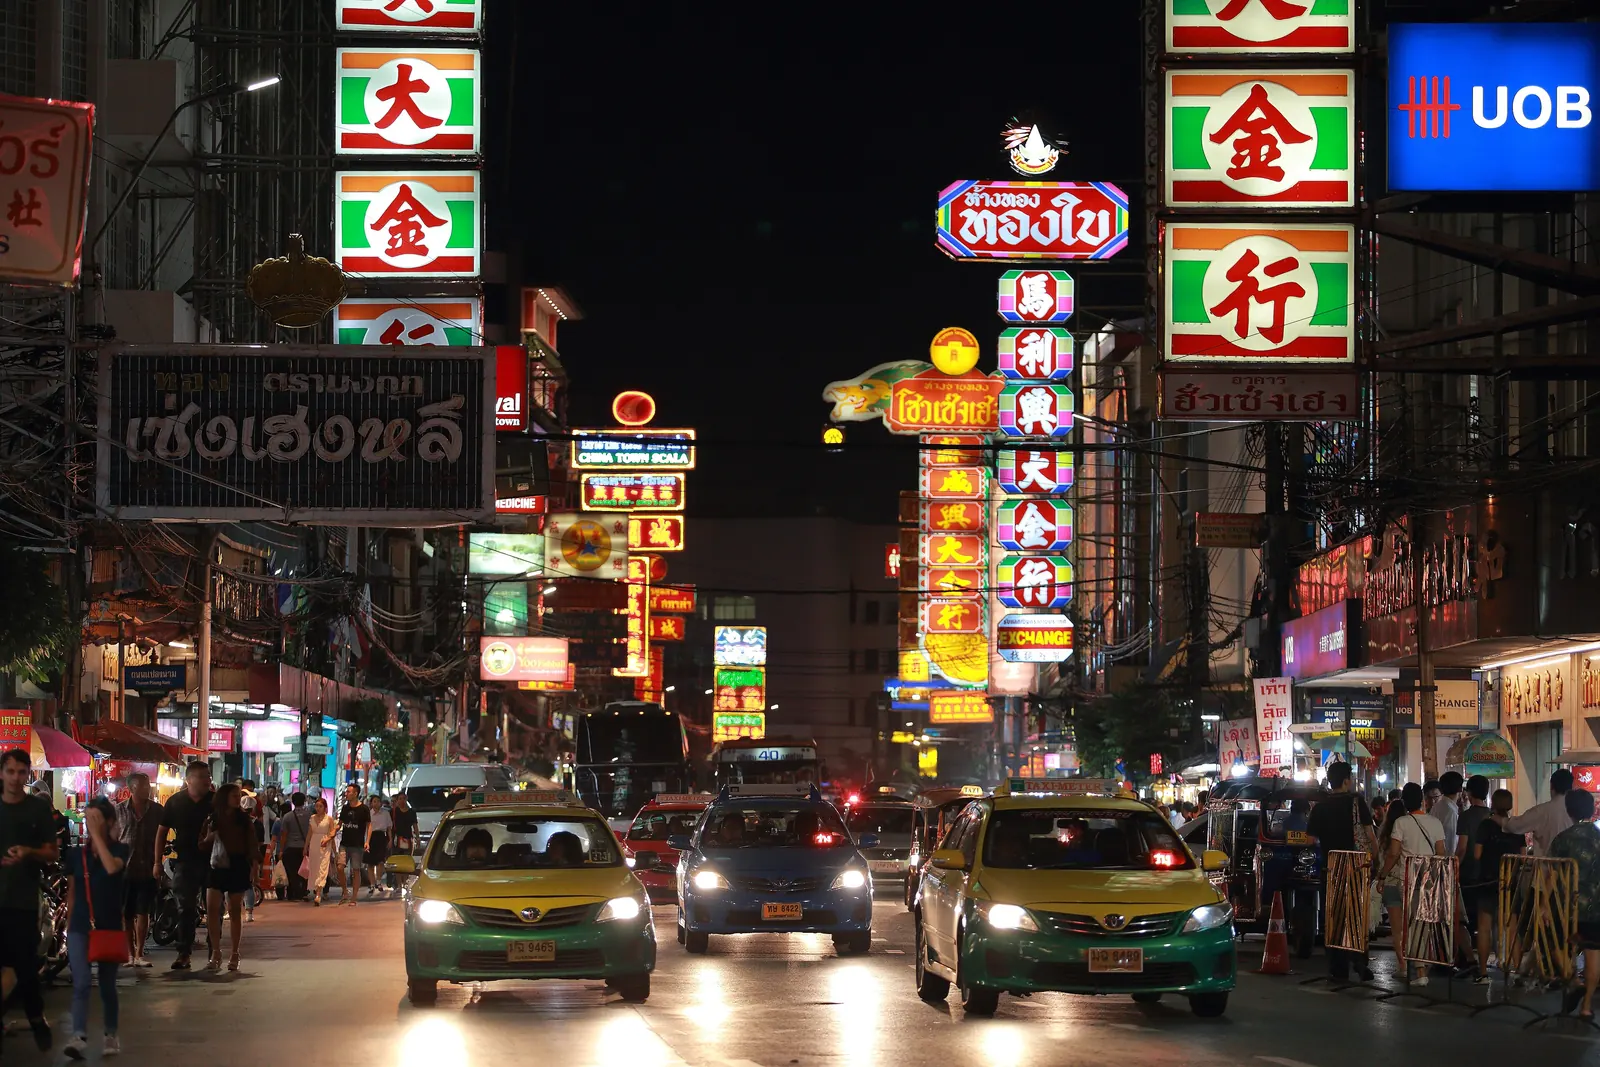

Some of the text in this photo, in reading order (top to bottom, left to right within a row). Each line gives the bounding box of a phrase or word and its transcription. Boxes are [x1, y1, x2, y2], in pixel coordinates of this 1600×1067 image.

[1471, 86, 1592, 129] UOB
[965, 187, 1040, 208] ห้างทอง
[959, 191, 1110, 246] ทองใบ
[1232, 376, 1287, 385] อาคาร
[579, 453, 689, 464] CHINA TOWN SCALA
[999, 630, 1072, 646] EXCHANGE
[1395, 707, 1413, 715] UOB
[758, 750, 779, 761] 40
[528, 942, 554, 952] 9465
